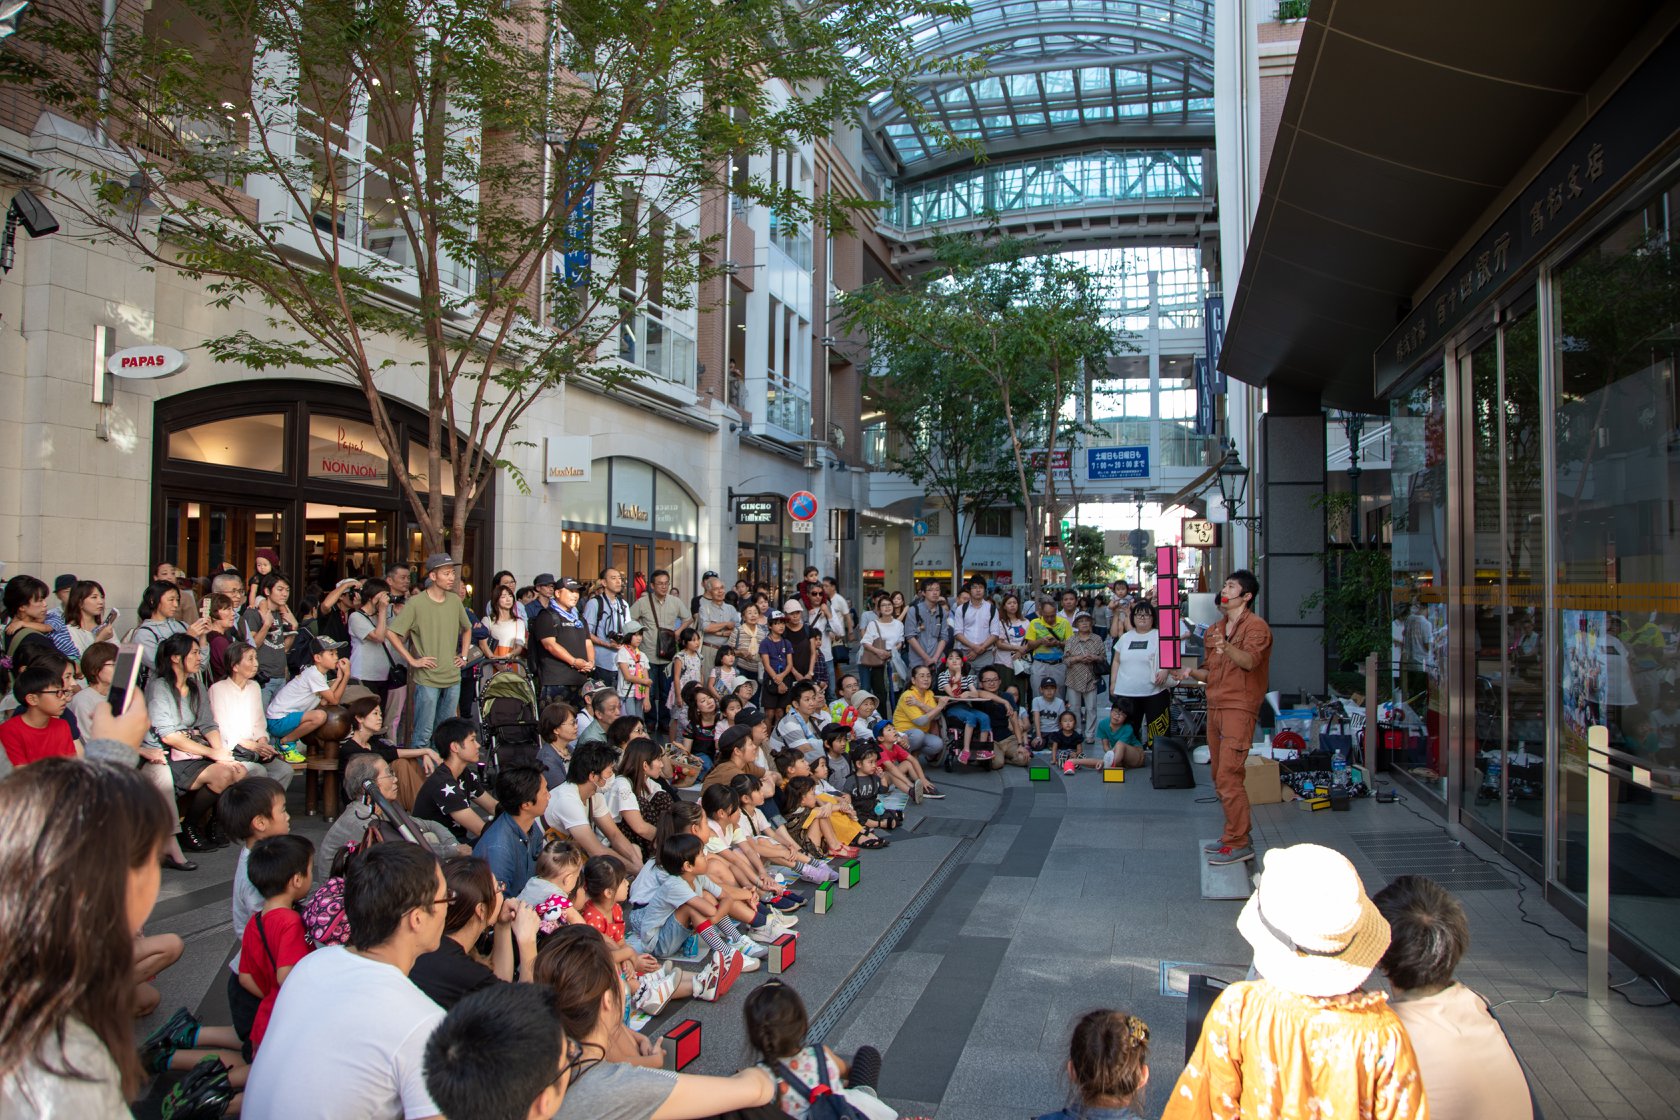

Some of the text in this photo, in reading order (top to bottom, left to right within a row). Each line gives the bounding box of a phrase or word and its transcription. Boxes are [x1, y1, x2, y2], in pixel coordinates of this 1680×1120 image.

[121, 355, 165, 368] PAPAS
[337, 423, 364, 455] Papas
[1095, 450, 1142, 461] 土曜日も日曜日も
[549, 466, 584, 477] MaxMara
[616, 503, 648, 522] MaxMara
